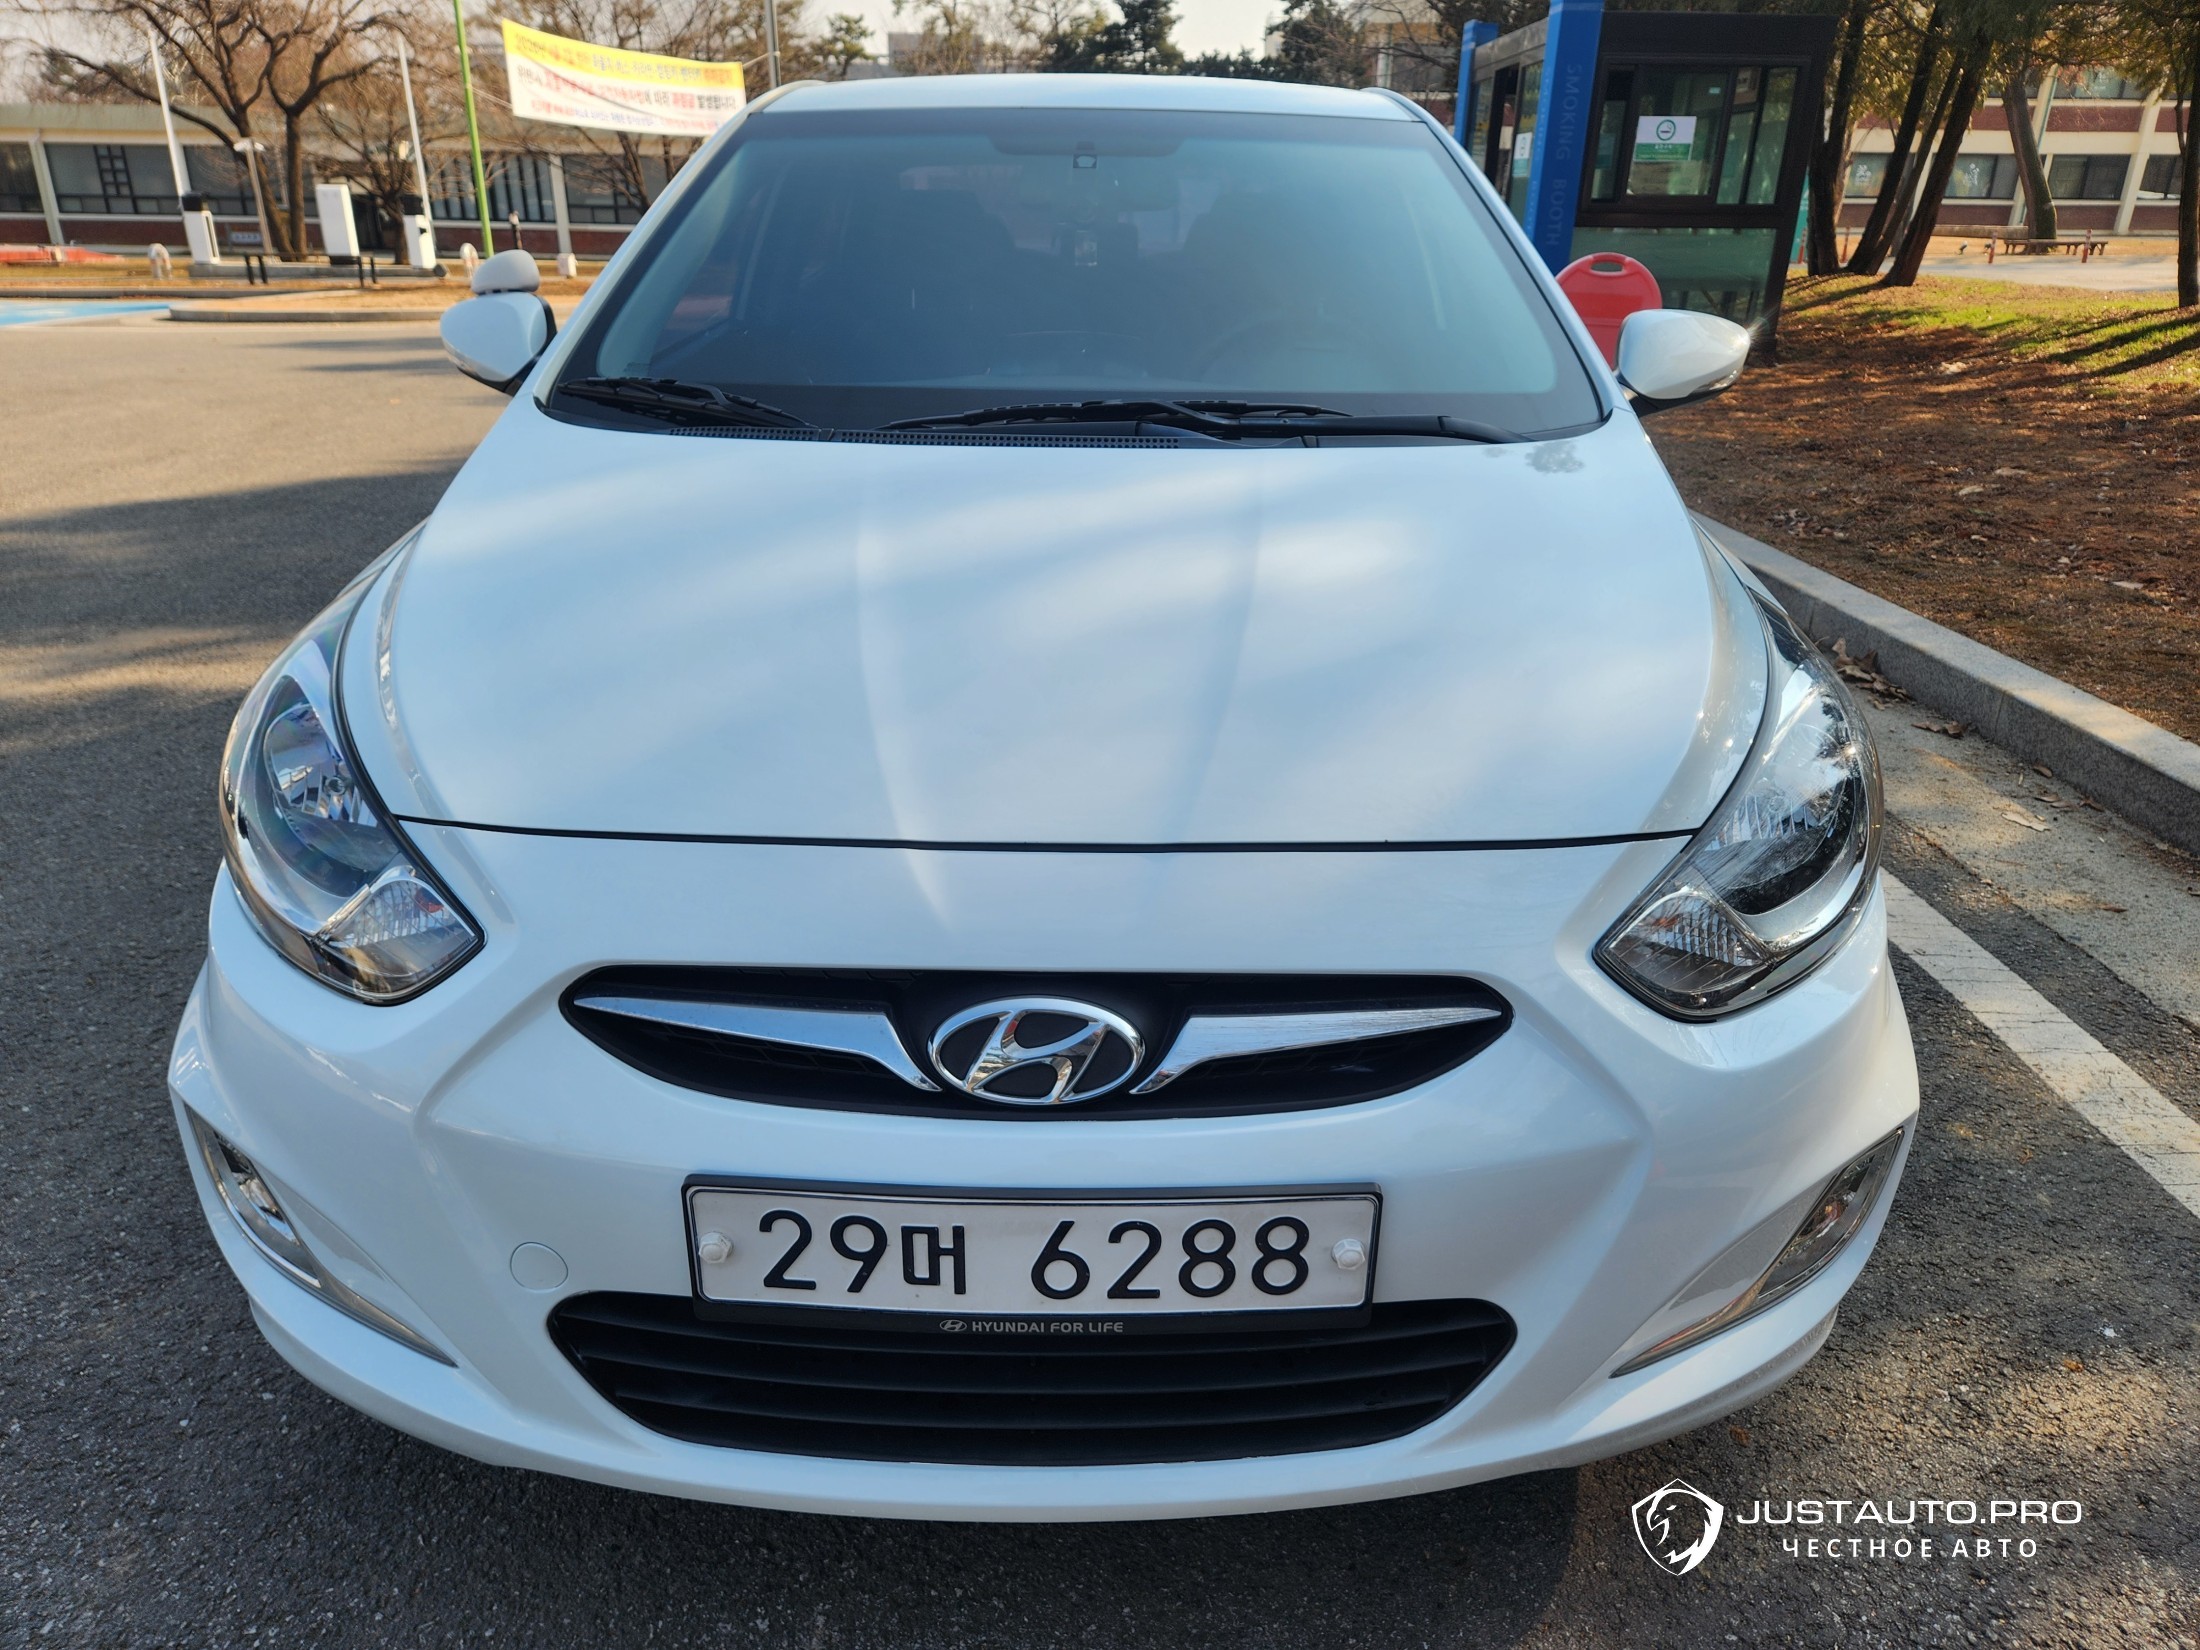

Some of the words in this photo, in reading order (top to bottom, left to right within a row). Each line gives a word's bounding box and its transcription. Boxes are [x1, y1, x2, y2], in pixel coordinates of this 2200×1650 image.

[1556, 64, 1581, 160] SMOKING
[1546, 179, 1567, 245] BOOTH
[758, 1210, 966, 1295] 29머
[1030, 1215, 1309, 1300] 6288
[972, 1321, 1044, 1333] HYUNDAI
[1050, 1322, 1083, 1333] FOR
[1088, 1322, 1123, 1333] LIFE
